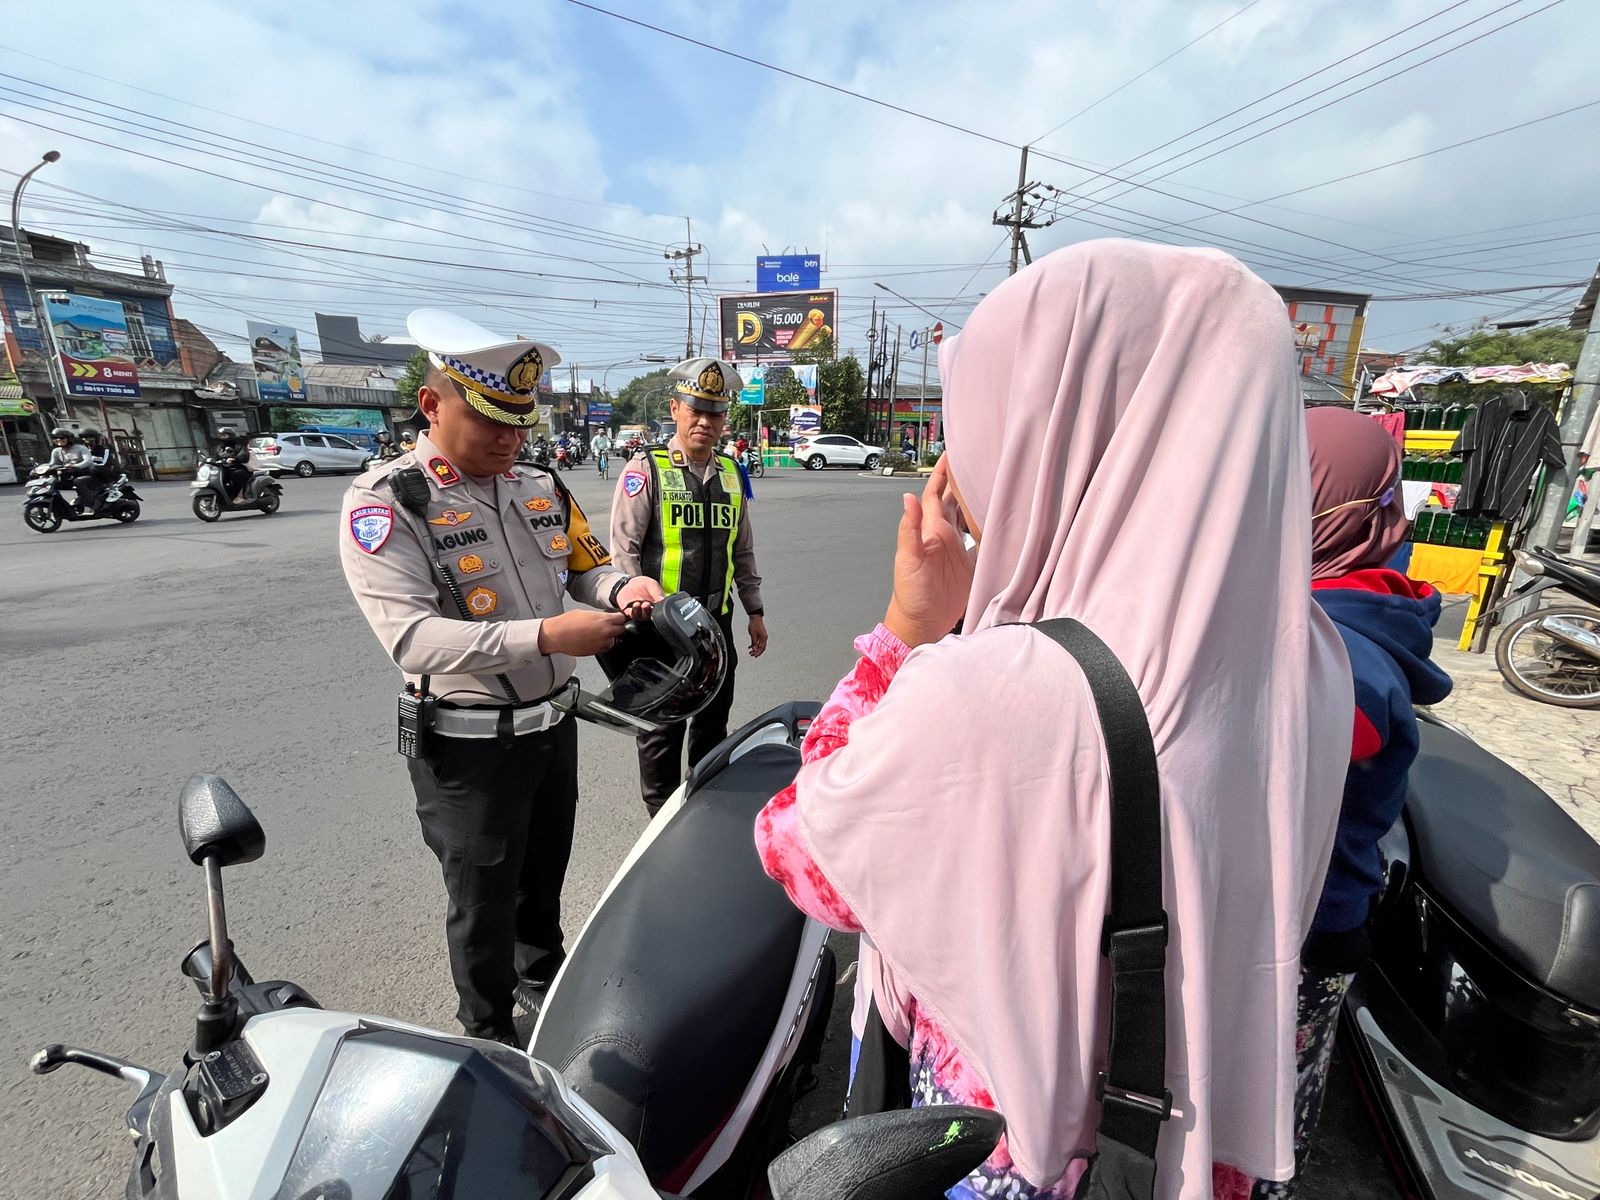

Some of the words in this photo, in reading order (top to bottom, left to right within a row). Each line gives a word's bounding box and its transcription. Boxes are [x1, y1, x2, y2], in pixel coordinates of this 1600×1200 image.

[804, 259, 818, 268] btn
[776, 272, 800, 282] bale
[772, 312, 804, 325] 15.000
[103, 367, 113, 378] 8
[368, 507, 389, 515] LINTAS
[671, 503, 737, 528] POLISI
